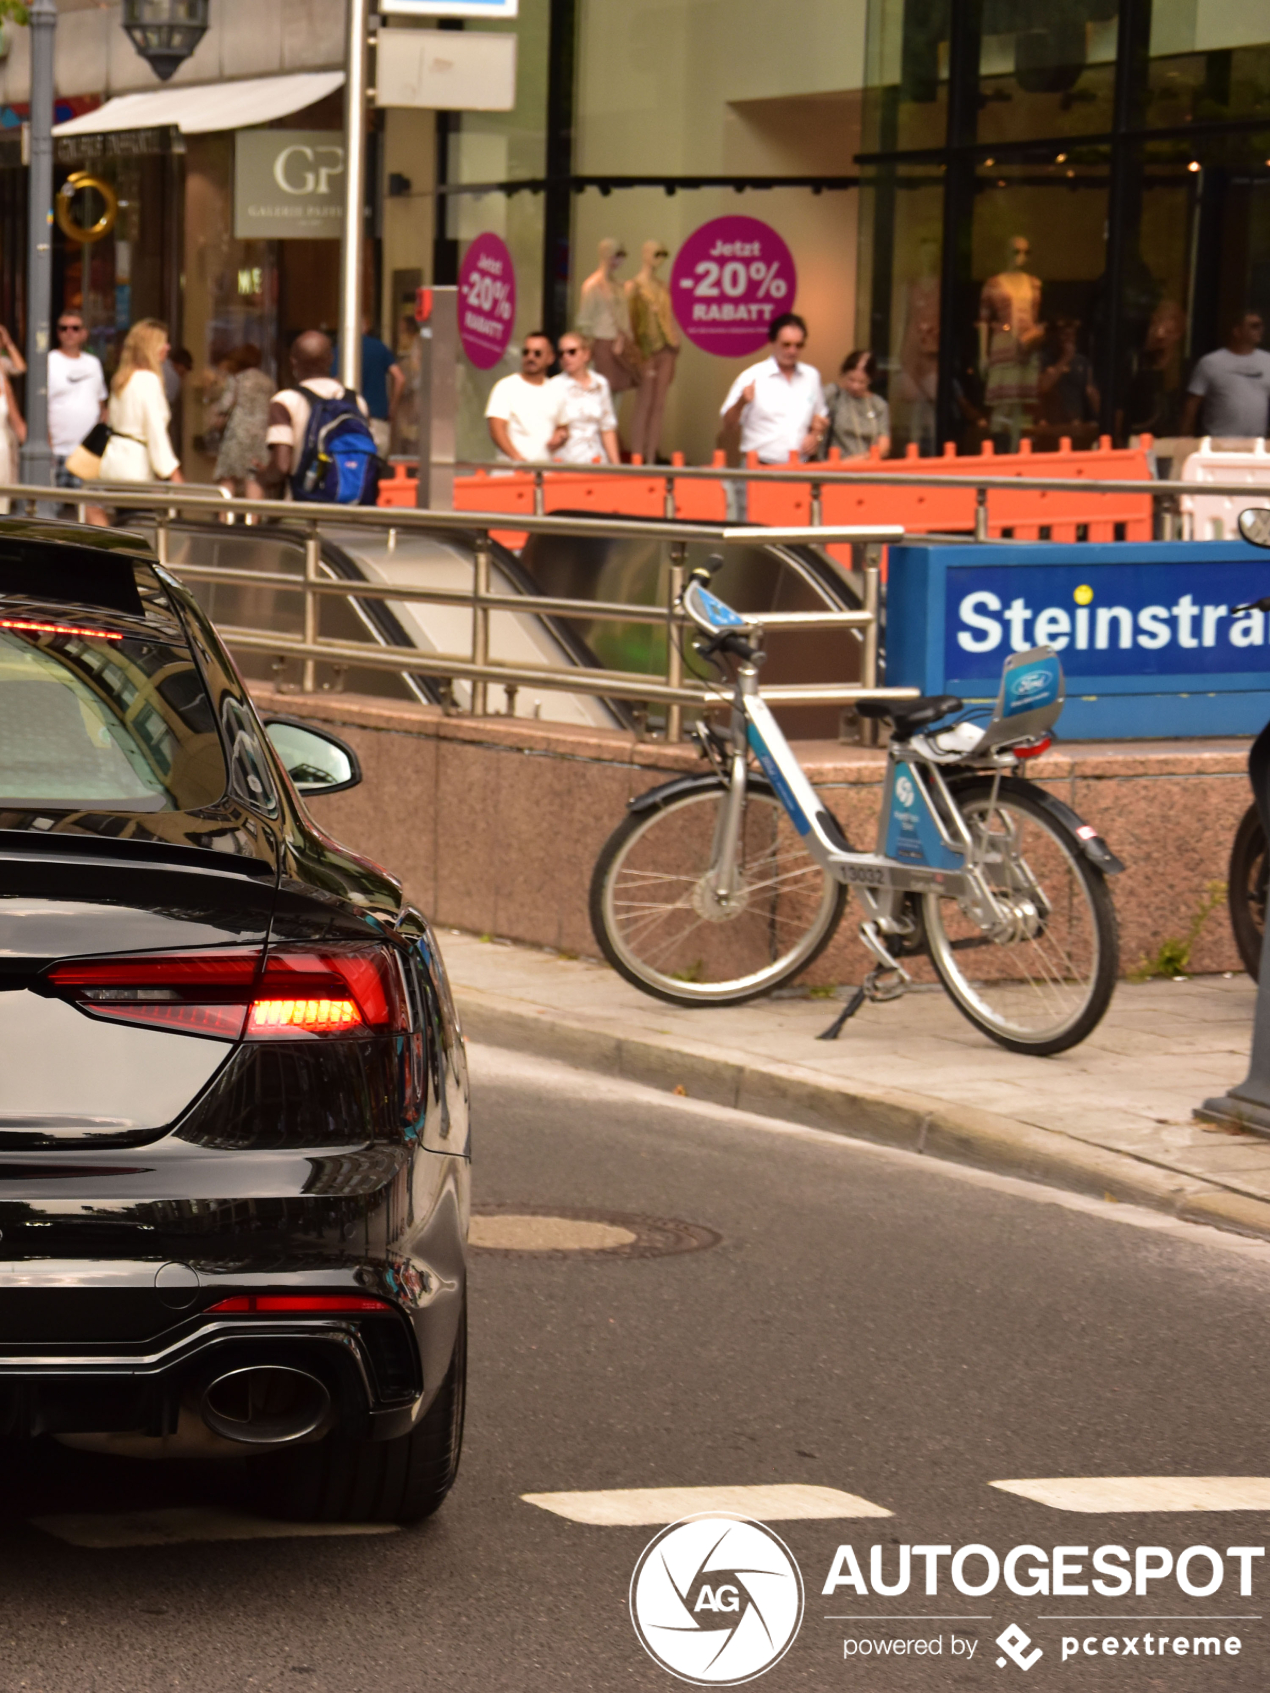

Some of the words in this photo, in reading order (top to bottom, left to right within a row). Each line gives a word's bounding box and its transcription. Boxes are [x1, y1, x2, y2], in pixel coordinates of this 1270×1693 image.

[273, 145, 345, 195] GP
[477, 252, 503, 276] Jetzt
[710, 240, 760, 257] Jetzt
[461, 271, 512, 321] -20%
[679, 260, 787, 299] -20%
[464, 311, 504, 340] RABATT
[693, 303, 774, 321] RABATT
[957, 585, 1270, 653] Steinstra
